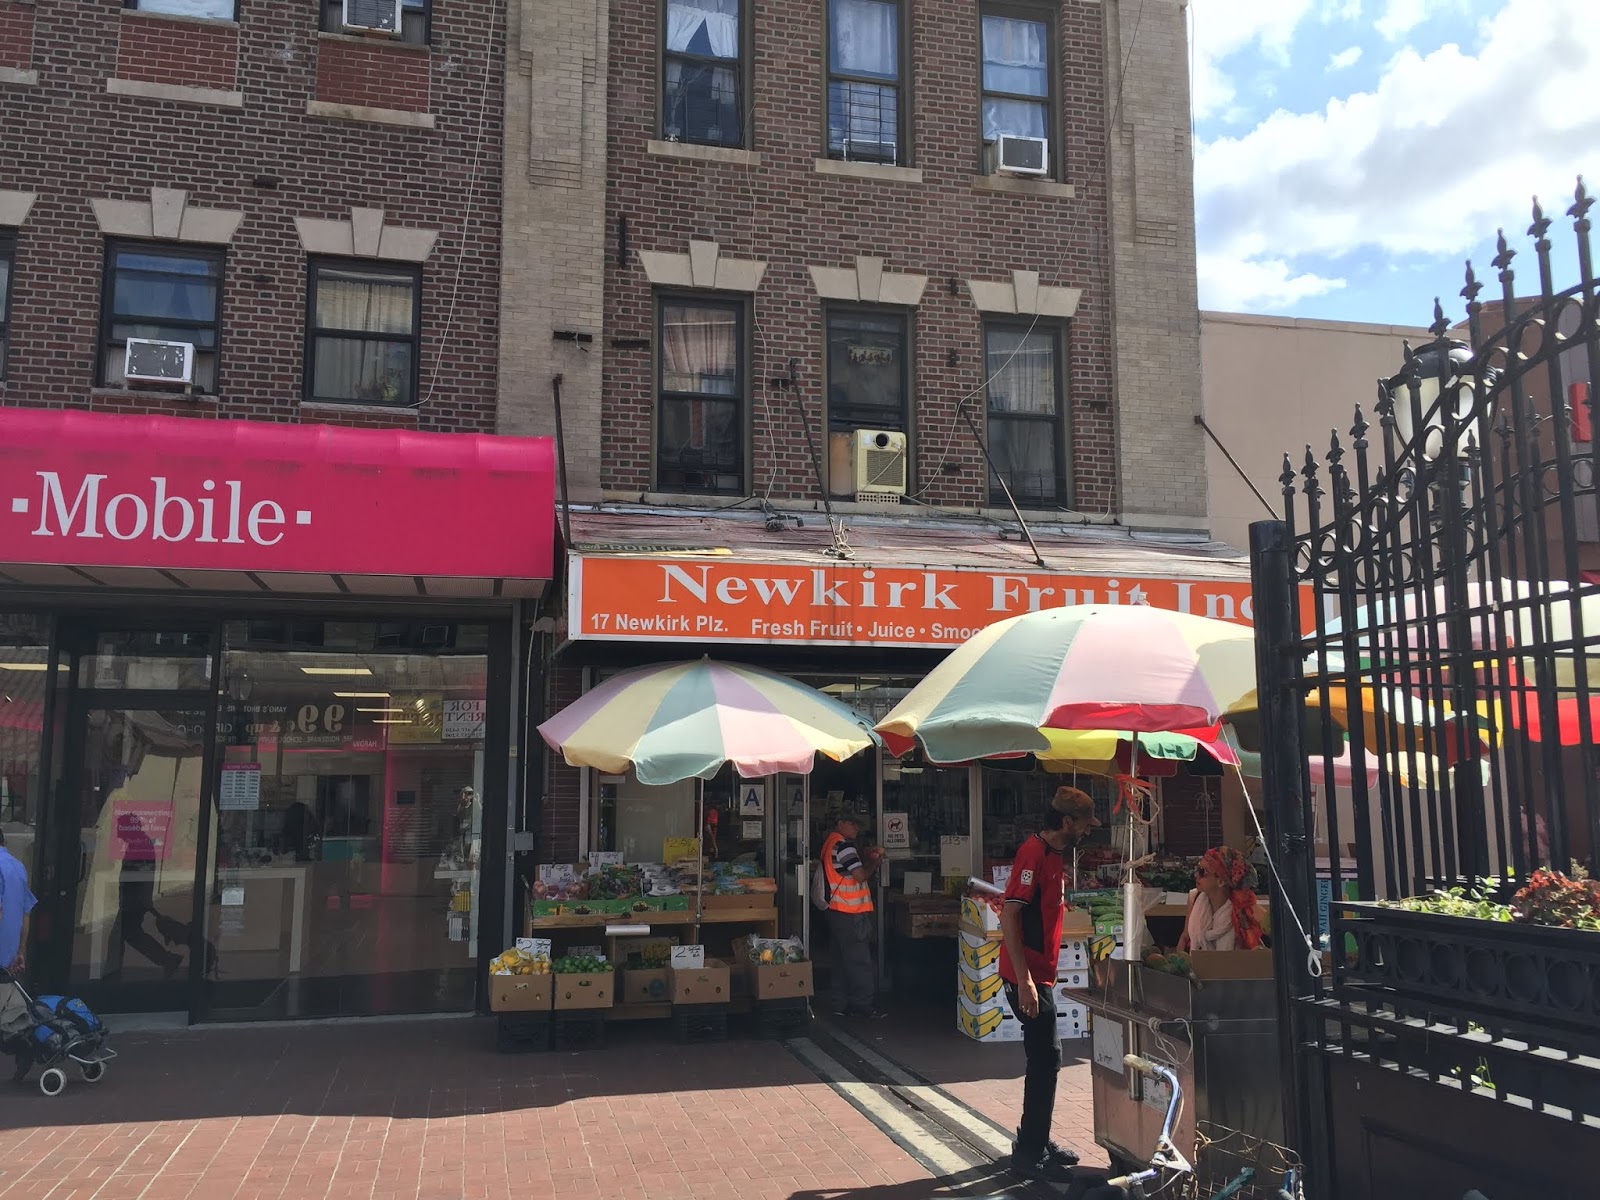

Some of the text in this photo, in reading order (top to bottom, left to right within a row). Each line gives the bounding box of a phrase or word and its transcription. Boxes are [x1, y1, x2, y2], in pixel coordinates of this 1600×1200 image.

[32, 471, 285, 546] Mobile
[656, 564, 961, 611] Newkirk
[986, 574, 1142, 612] Fruit
[591, 612, 609, 631] 17
[615, 613, 691, 632] Newkirk
[696, 616, 729, 633] Plz.
[751, 618, 804, 636] Fresh
[810, 620, 853, 638] Fruit
[867, 621, 915, 639] Juice
[744, 788, 760, 806] A
